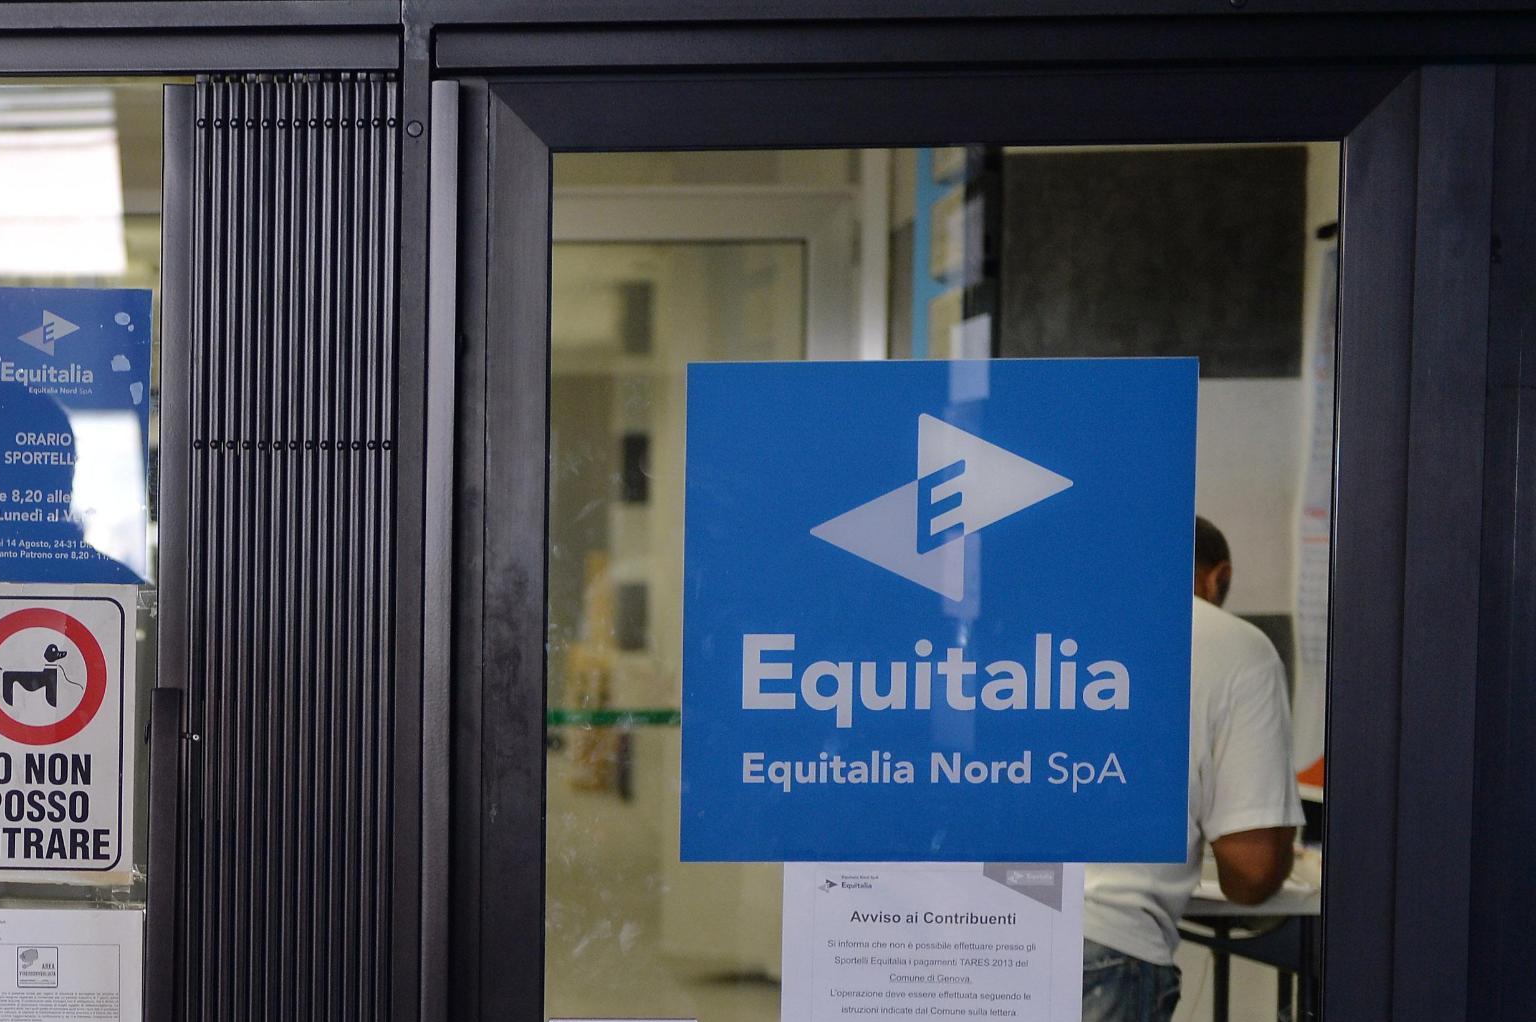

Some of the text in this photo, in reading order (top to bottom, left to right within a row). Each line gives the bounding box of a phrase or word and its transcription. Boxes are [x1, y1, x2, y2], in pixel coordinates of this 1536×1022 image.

[1, 362, 93, 386] Equitalia
[29, 387, 57, 395] Equitalia
[16, 432, 71, 446] ORARIO
[5, 452, 78, 465] SPORTELL
[12, 490, 42, 504] 8,20
[47, 490, 72, 503] alle
[47, 509, 58, 522] al
[7, 539, 16, 547] 14
[19, 540, 51, 549] Agosto,
[54, 540, 77, 548] 24-31
[20, 550, 52, 559] Patrono
[742, 633, 1130, 728] Equitalia
[25, 753, 91, 785] NON
[742, 751, 1127, 792] Equitalia Nord SpA
[850, 910, 1016, 924] Avviso ai Contribuenti
[827, 940, 836, 948] Si
[838, 940, 869, 948] informa
[915, 942, 951, 950] possibile
[954, 942, 993, 950] effettuare
[996, 944, 1024, 952] presso
[1027, 943, 1036, 952] gli
[834, 956, 868, 965] Sportelli
[870, 956, 906, 966] Equitalia
[914, 958, 957, 967] pagamenti
[960, 959, 990, 967] TARES
[992, 959, 1013, 967] 2013
[889, 973, 924, 982] Comune
[927, 974, 934, 982] di
[830, 988, 883, 998] L'operazione
[885, 990, 905, 998] deve
[939, 991, 978, 999] effettuata
[980, 992, 1022, 1001] seguendo
[1024, 992, 1031, 1000] le
[841, 1006, 878, 1014] istruzioni
[881, 1006, 913, 1014] indicate
[930, 1007, 965, 1015] Comune
[968, 1008, 987, 1016] sulla
